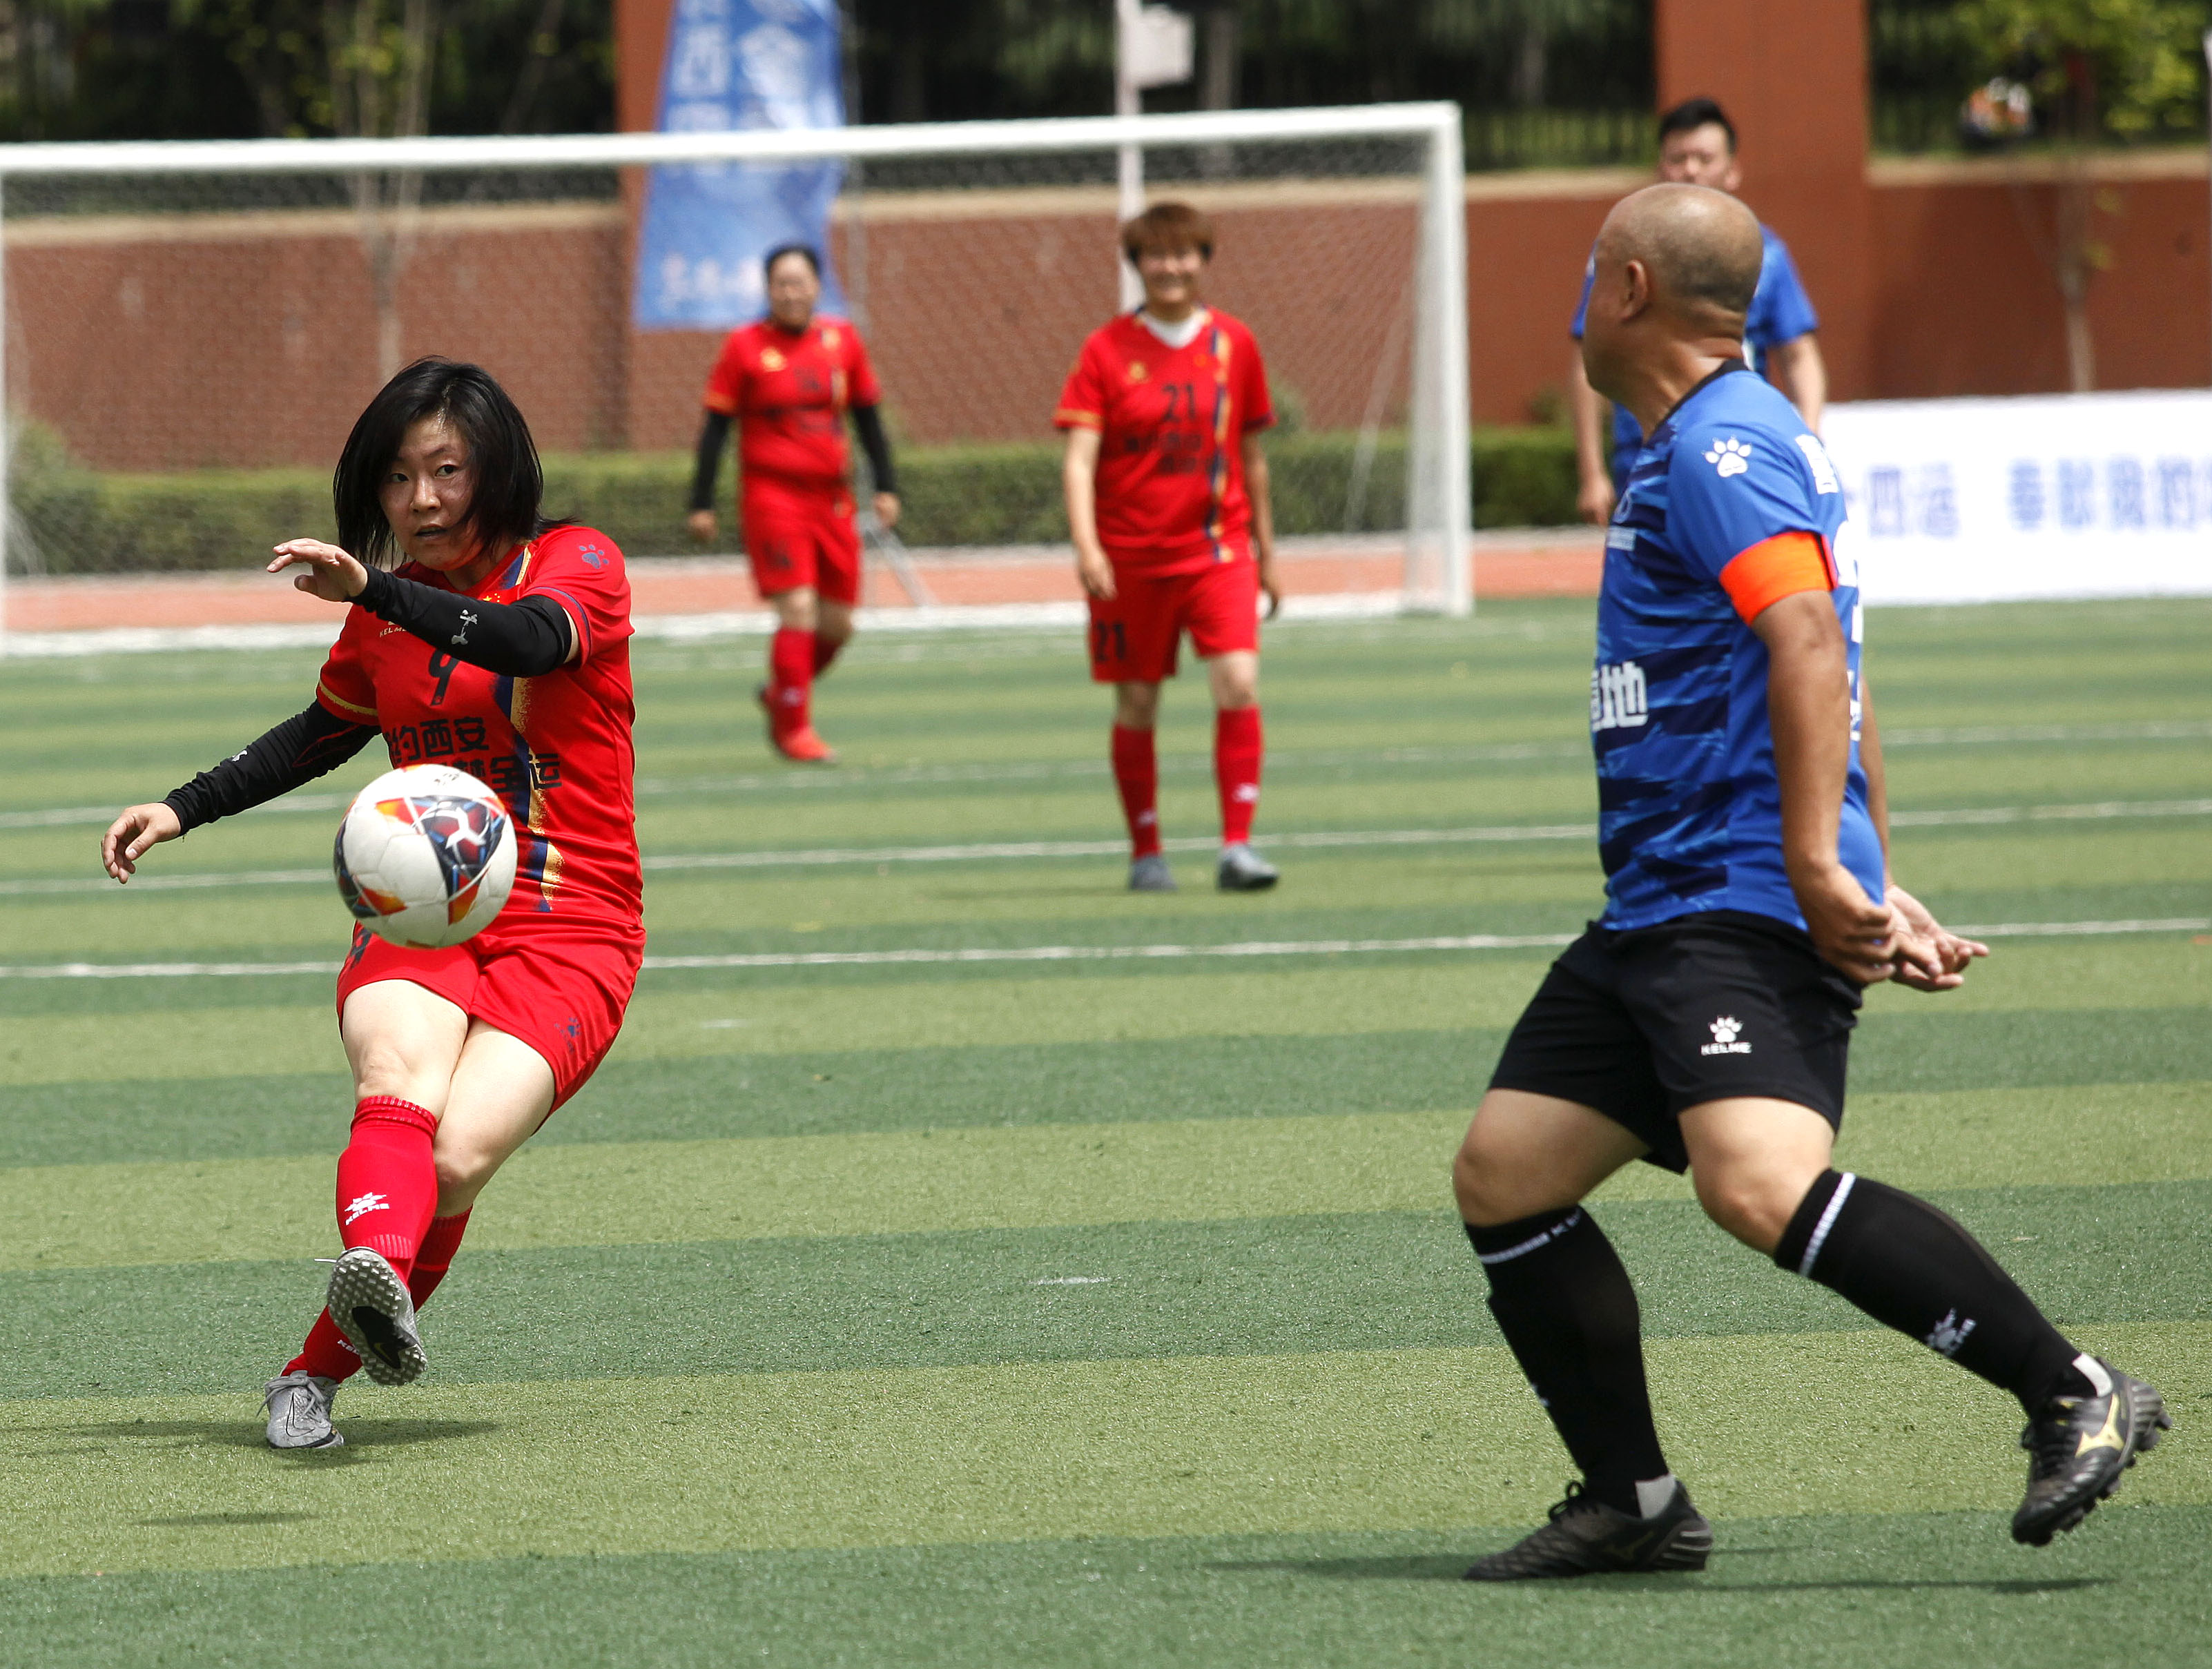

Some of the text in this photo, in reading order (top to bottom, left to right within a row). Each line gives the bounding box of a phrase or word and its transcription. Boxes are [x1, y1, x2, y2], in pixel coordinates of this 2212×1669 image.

[1162, 384, 1196, 422] 21
[428, 648, 460, 707] 9
[1590, 661, 1649, 732] 地
[384, 716, 489, 763] 约西安
[345, 1203, 389, 1225] KELME
